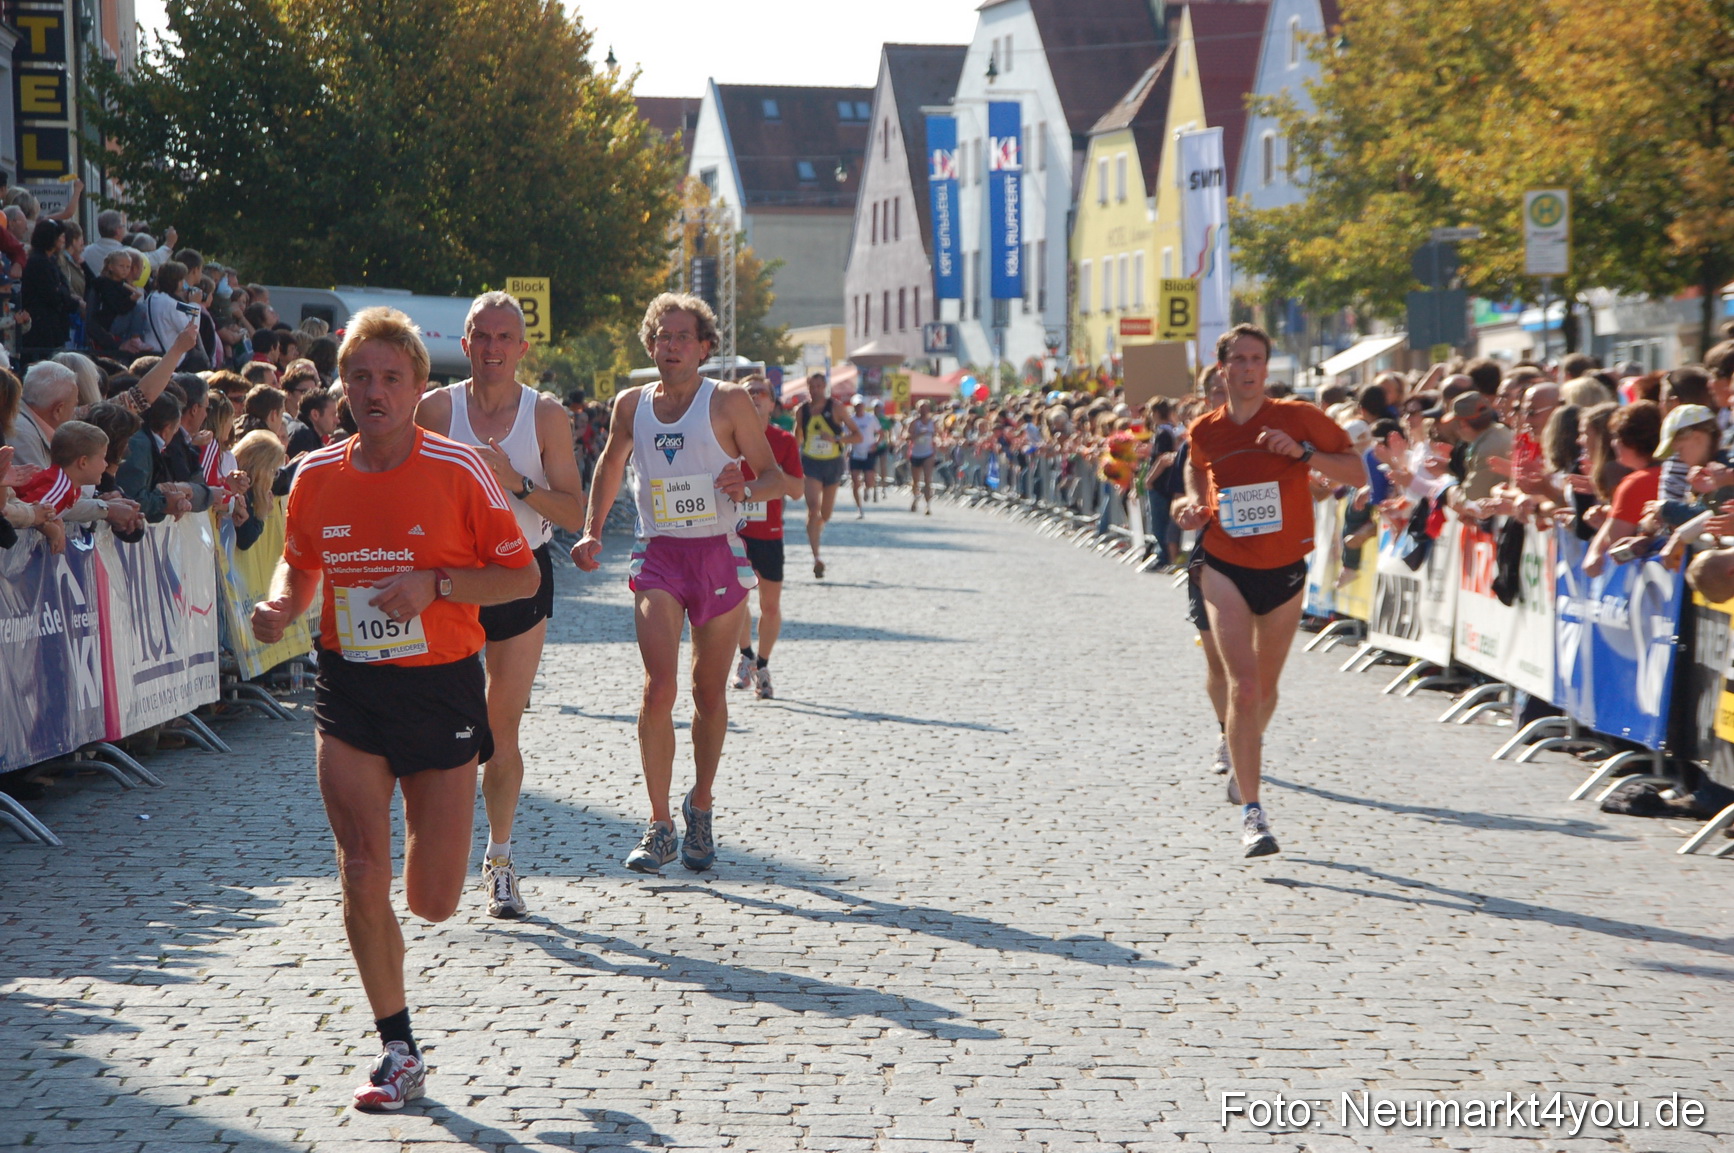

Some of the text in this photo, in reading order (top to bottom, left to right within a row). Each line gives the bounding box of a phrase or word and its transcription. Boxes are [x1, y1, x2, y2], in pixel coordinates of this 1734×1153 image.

[1005, 175, 1018, 246] RUPPERT
[512, 281, 545, 292] Block
[1165, 280, 1196, 292] Block
[519, 297, 540, 328] B
[1170, 297, 1190, 327] B
[600, 380, 610, 393] C
[897, 381, 907, 396] C
[667, 481, 691, 492] Jakob
[1232, 487, 1279, 503] ANDREAS
[675, 497, 706, 514] 698
[1237, 504, 1276, 522] 3699
[322, 525, 351, 538] DAK
[322, 548, 415, 565] SportScheck
[363, 565, 395, 573] Stadtlauf
[396, 565, 414, 573] 2007
[357, 619, 412, 640] 1057
[390, 642, 426, 653] PFLEIDERER
